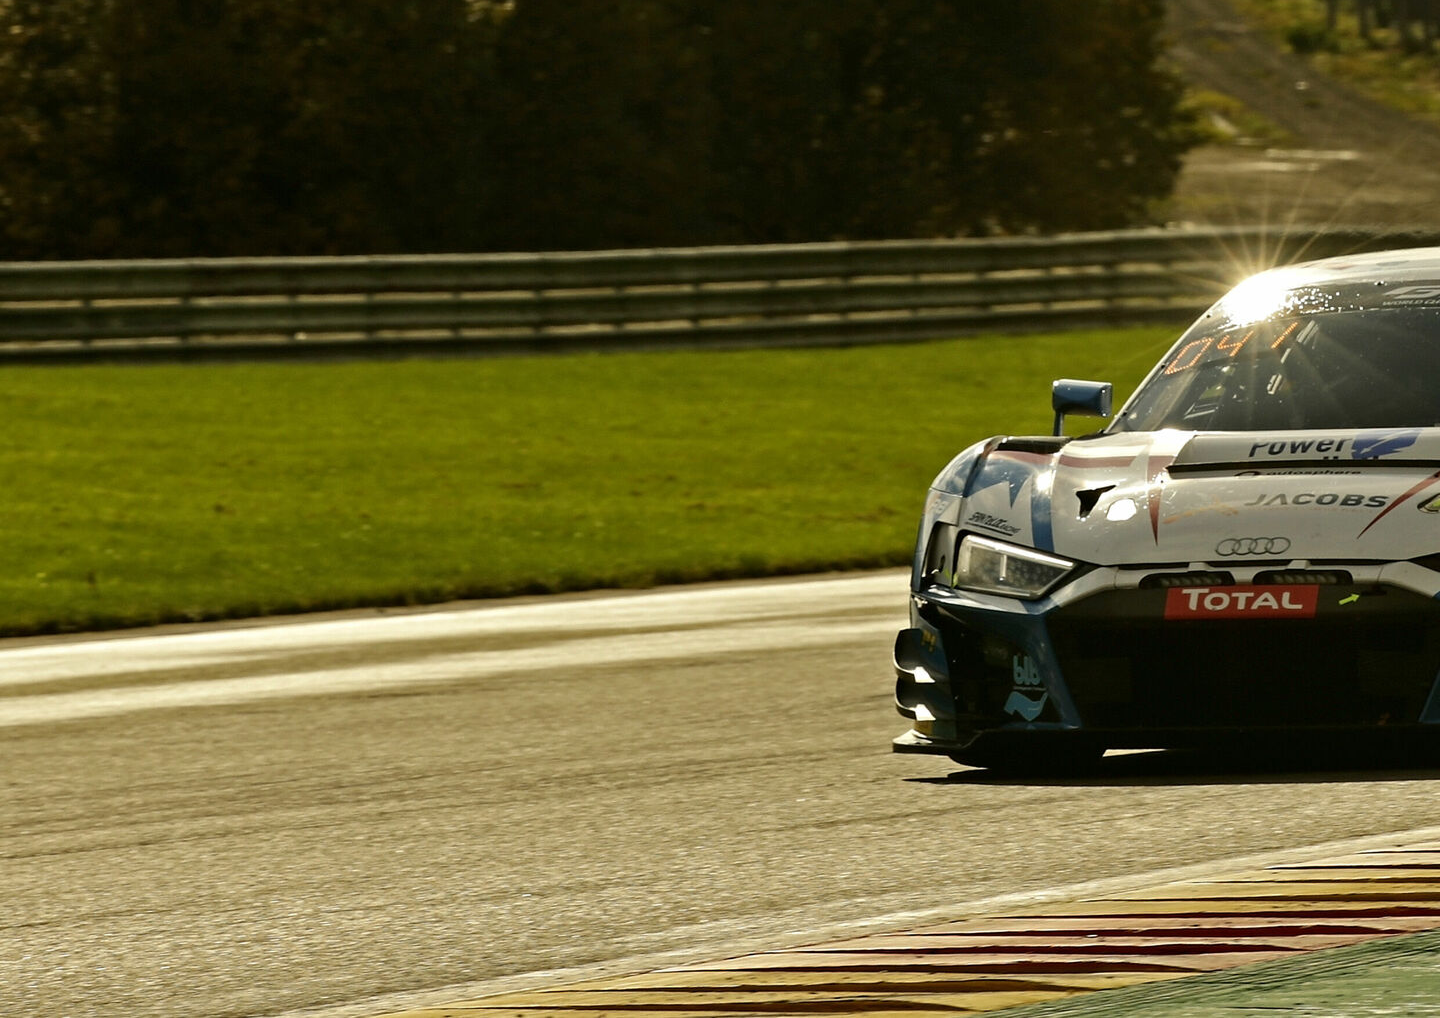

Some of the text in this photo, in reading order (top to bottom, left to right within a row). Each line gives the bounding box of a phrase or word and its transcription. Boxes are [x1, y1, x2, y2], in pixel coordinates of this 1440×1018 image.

[1248, 438, 1352, 457] Power
[1244, 493, 1390, 508] JACOBS
[1181, 588, 1303, 611] TOTAL
